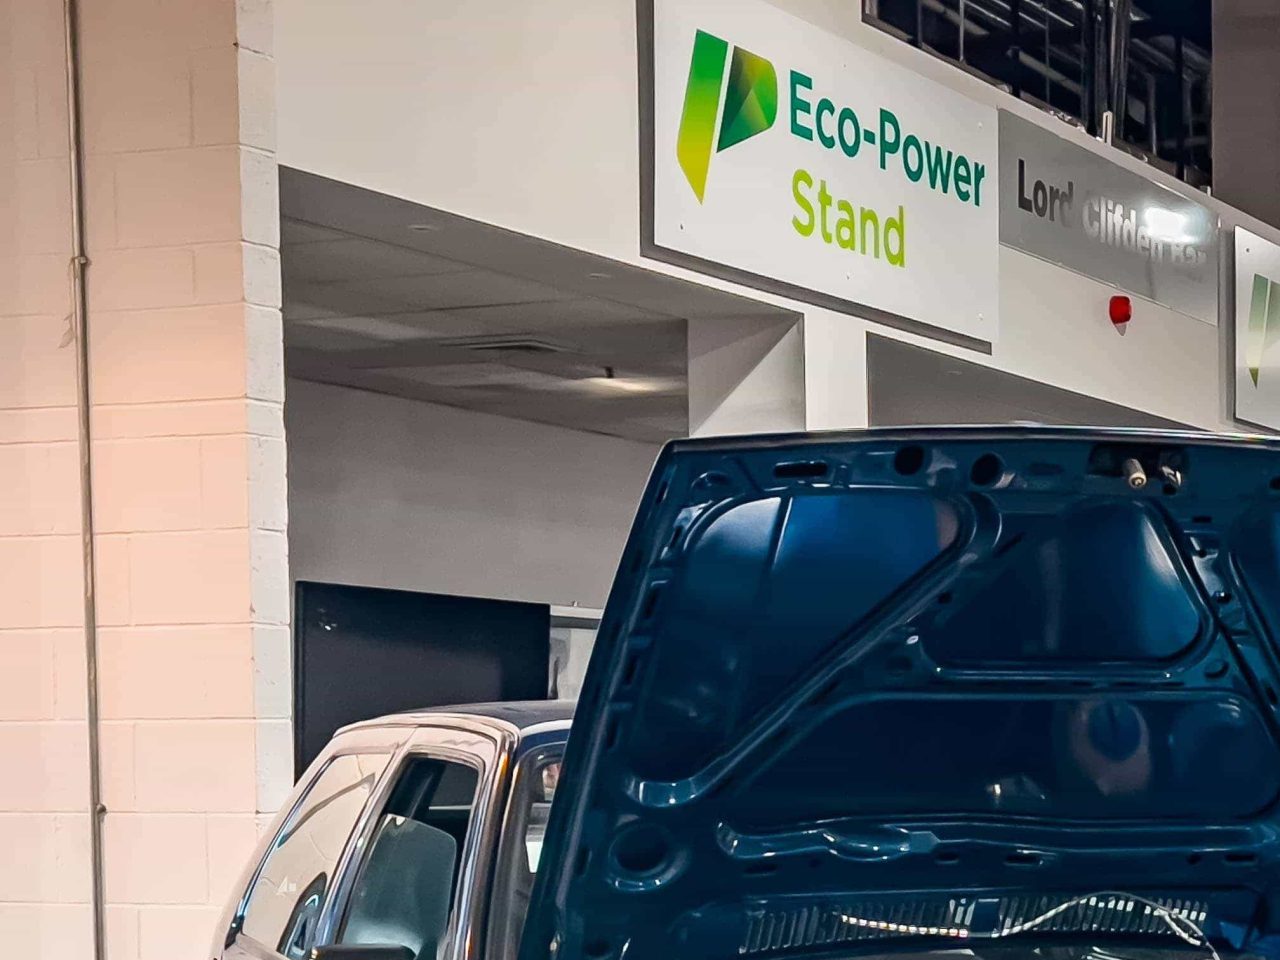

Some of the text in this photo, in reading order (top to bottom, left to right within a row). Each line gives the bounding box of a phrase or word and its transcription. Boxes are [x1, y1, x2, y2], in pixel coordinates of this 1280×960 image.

[790, 69, 985, 207] Eco-Power
[792, 169, 905, 268] Stand
[1018, 158, 1074, 229] Lord
